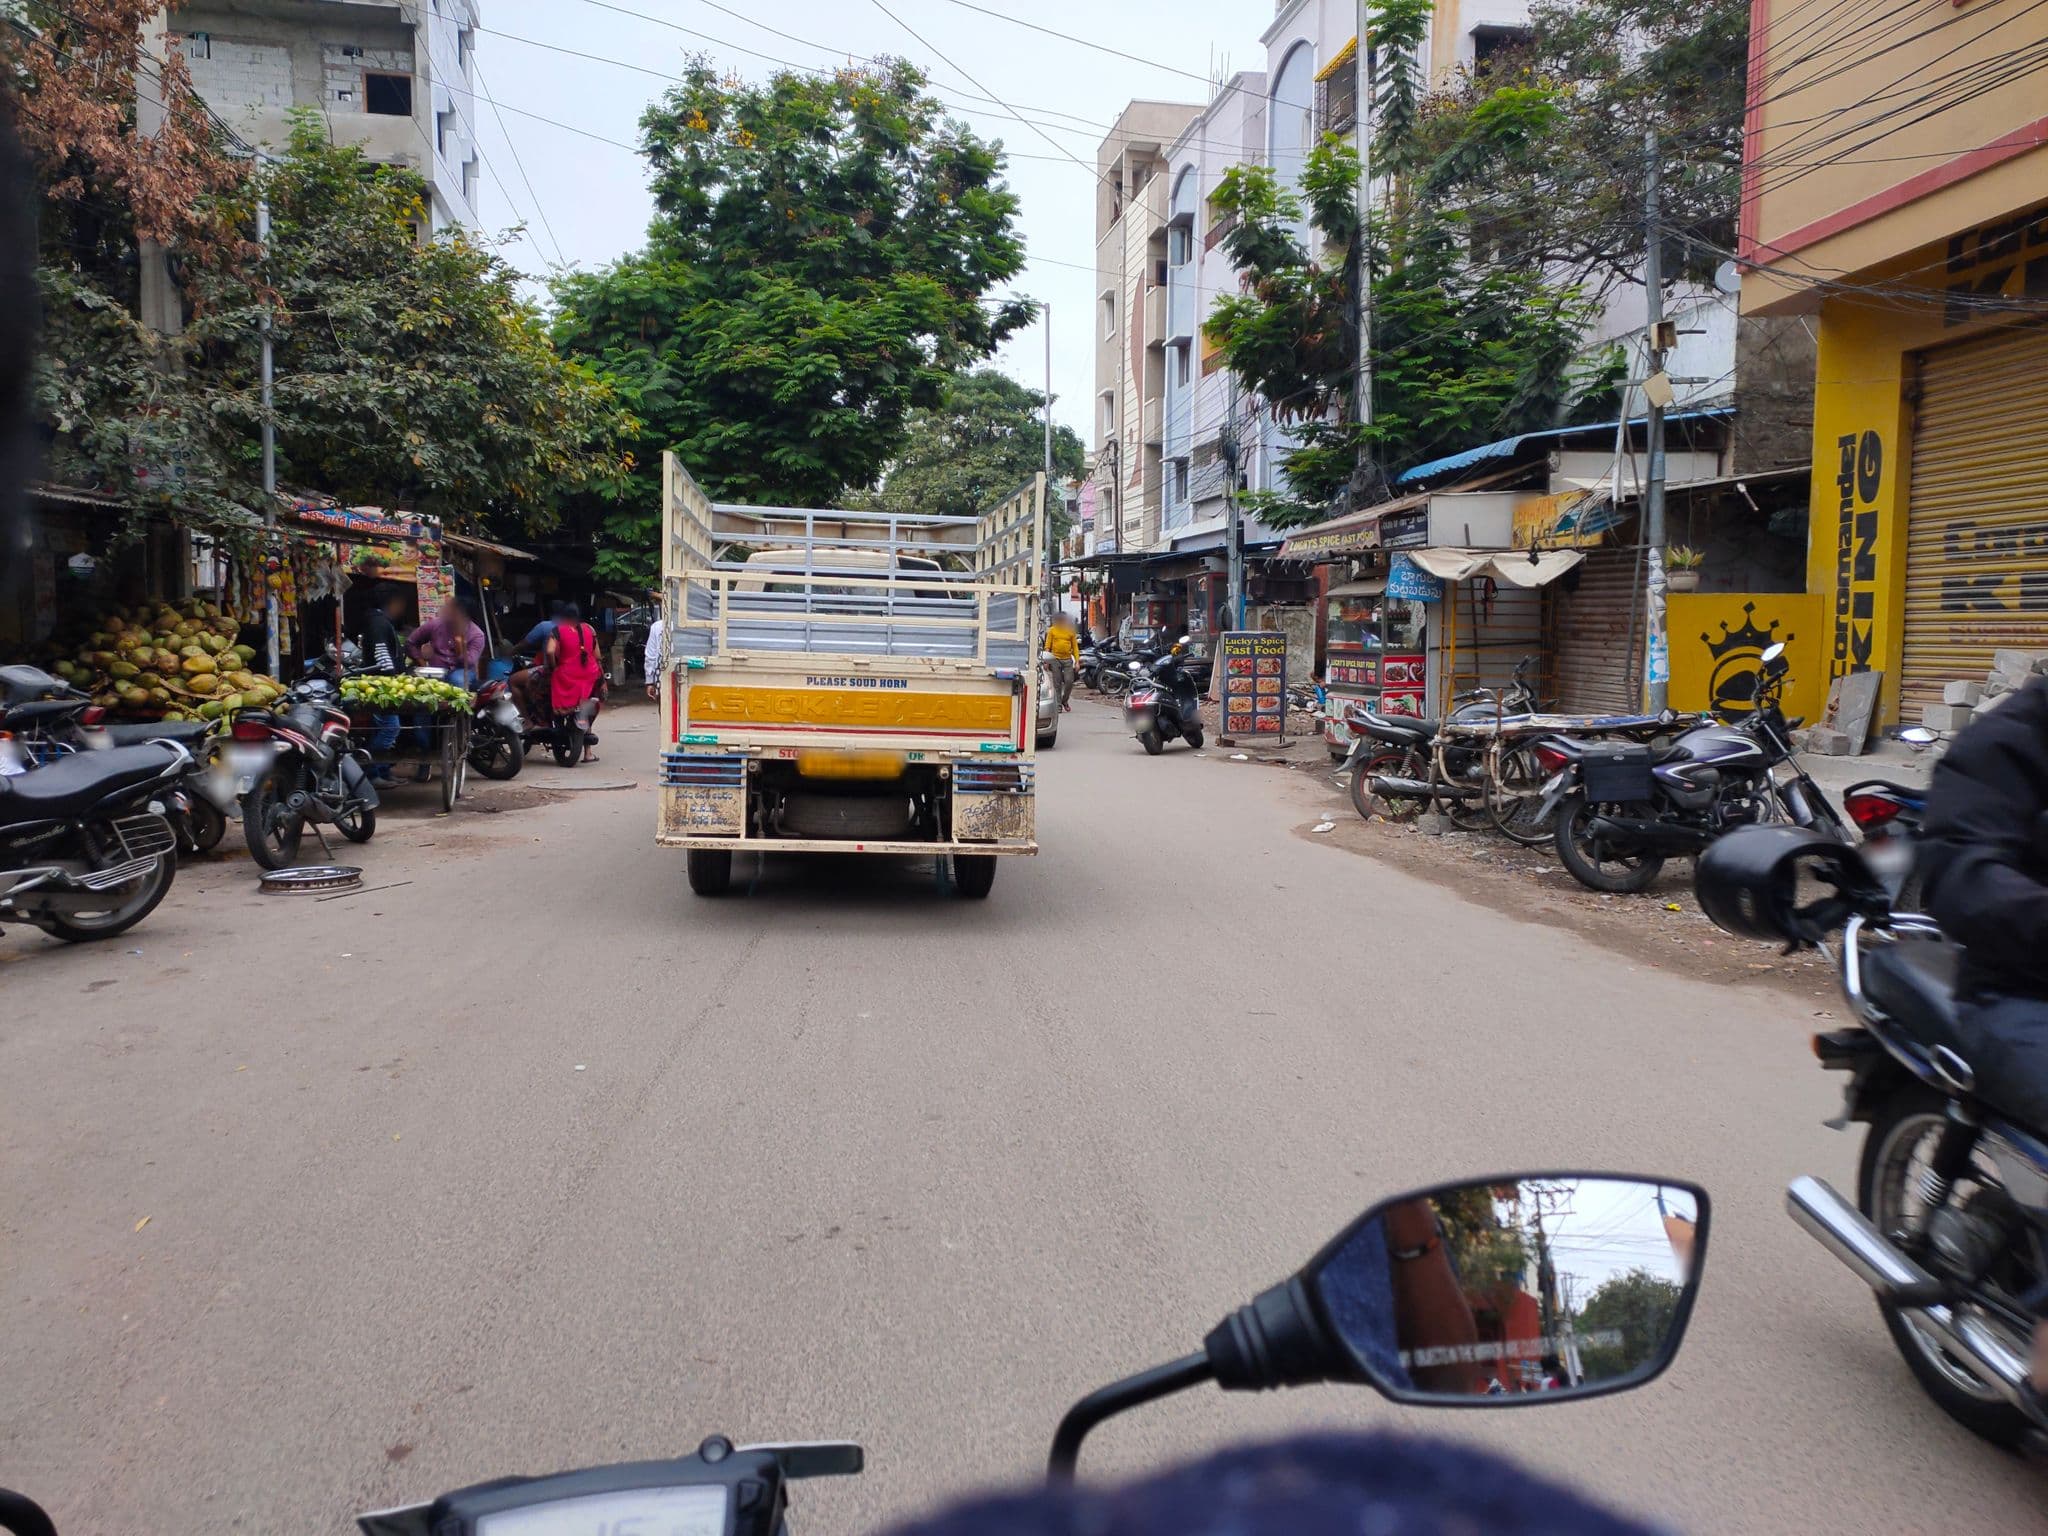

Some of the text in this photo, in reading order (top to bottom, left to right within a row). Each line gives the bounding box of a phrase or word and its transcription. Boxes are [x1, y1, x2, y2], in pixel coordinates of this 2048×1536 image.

[1851, 429, 1882, 674] KING
[1261, 637, 1285, 645] Spice
[1225, 645, 1285, 655] Fast Food
[806, 676, 908, 689] PLEASE SOUD HORN
